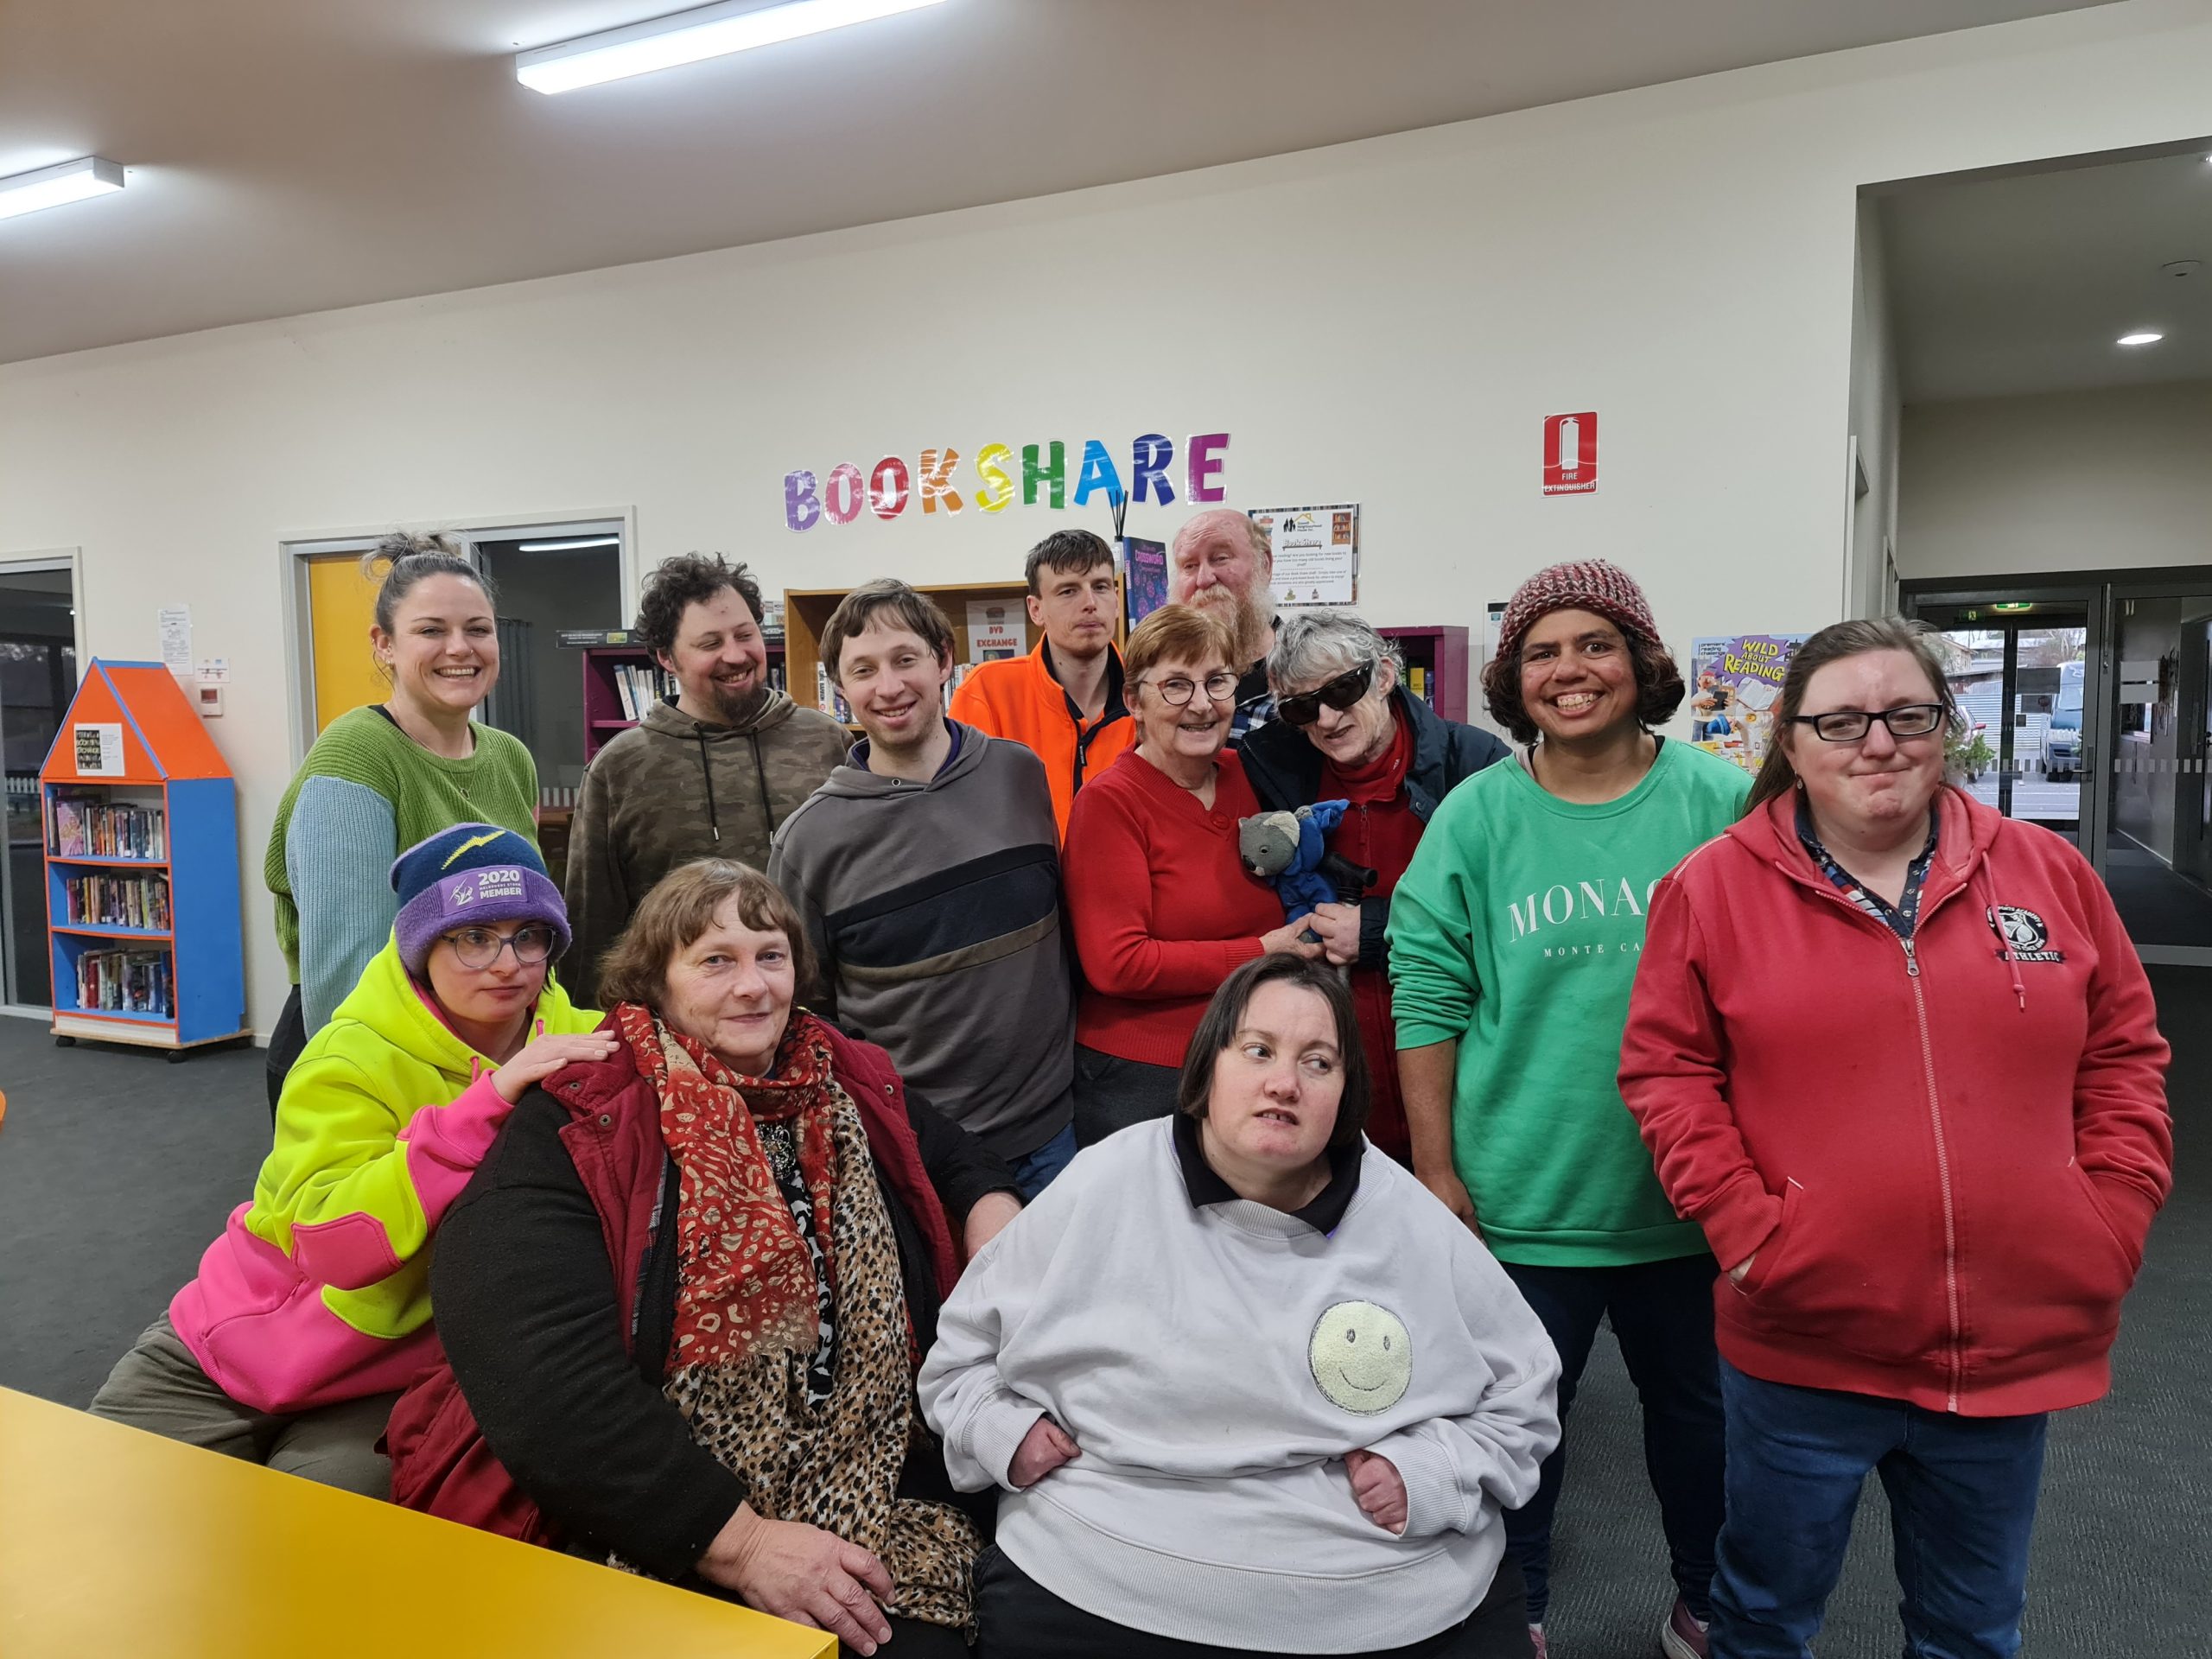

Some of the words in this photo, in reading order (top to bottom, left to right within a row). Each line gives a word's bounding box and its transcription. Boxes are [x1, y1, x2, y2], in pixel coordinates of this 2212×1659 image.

[1544, 482, 1595, 493] EXTINGUISHER
[988, 626, 1004, 634] DVD
[976, 639, 1018, 648] EXCHANGE
[1742, 639, 1778, 656] WILD
[1741, 652, 1771, 663] ABOUT
[1724, 653, 1786, 682] READING
[478, 870, 519, 886] 2020
[480, 887, 522, 899] MEMBER
[1544, 944, 1605, 957] MONTE
[1620, 942, 1641, 952] CA
